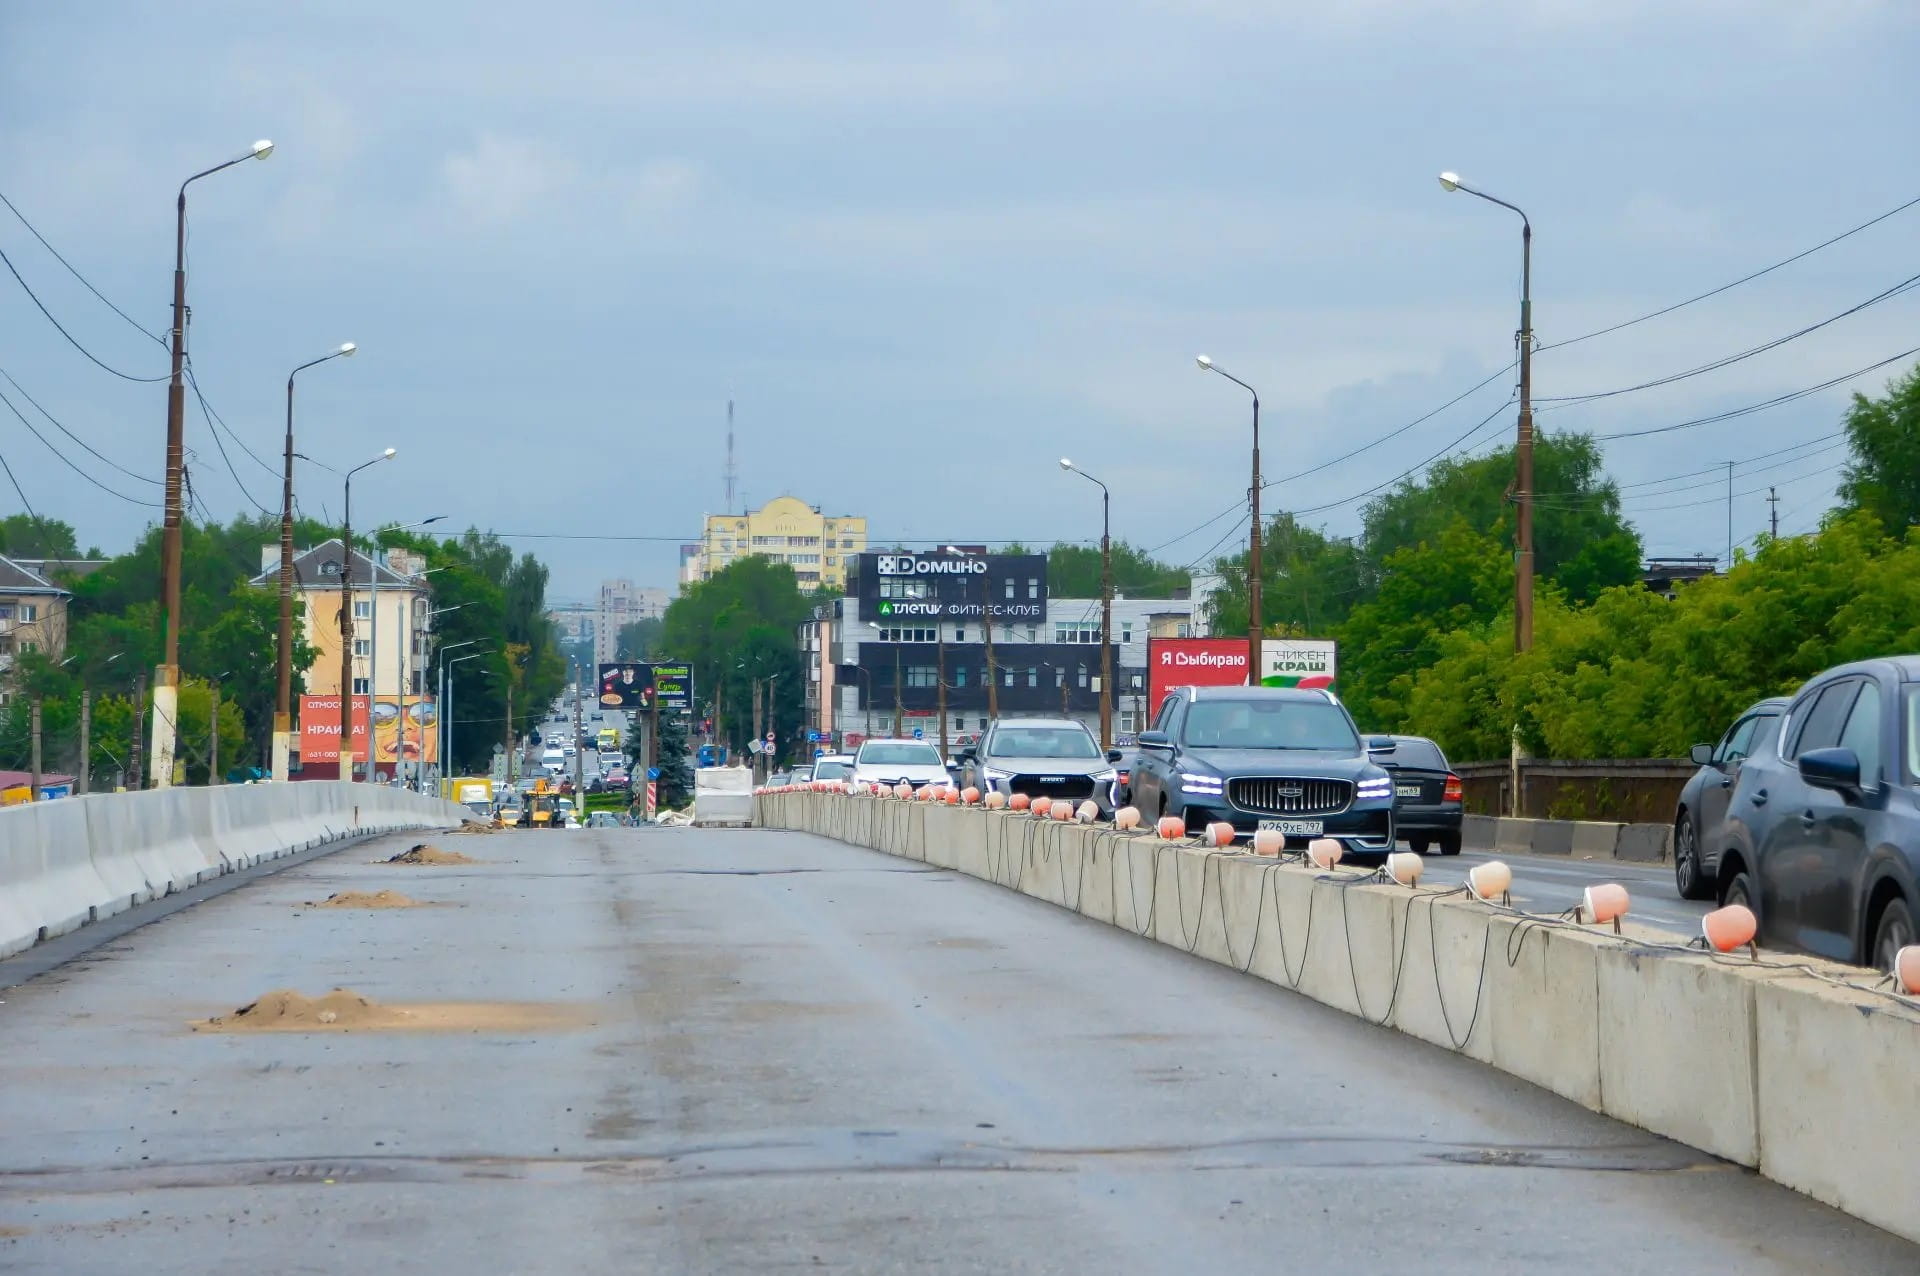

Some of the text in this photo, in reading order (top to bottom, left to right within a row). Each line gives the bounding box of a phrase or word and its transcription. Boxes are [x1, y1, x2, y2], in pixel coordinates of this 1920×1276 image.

[1161, 651, 1246, 669] Я Выбираю
[1276, 651, 1326, 661] ЧИКЕН
[1273, 661, 1326, 672] КРАШ
[1305, 822, 1322, 832] 797
